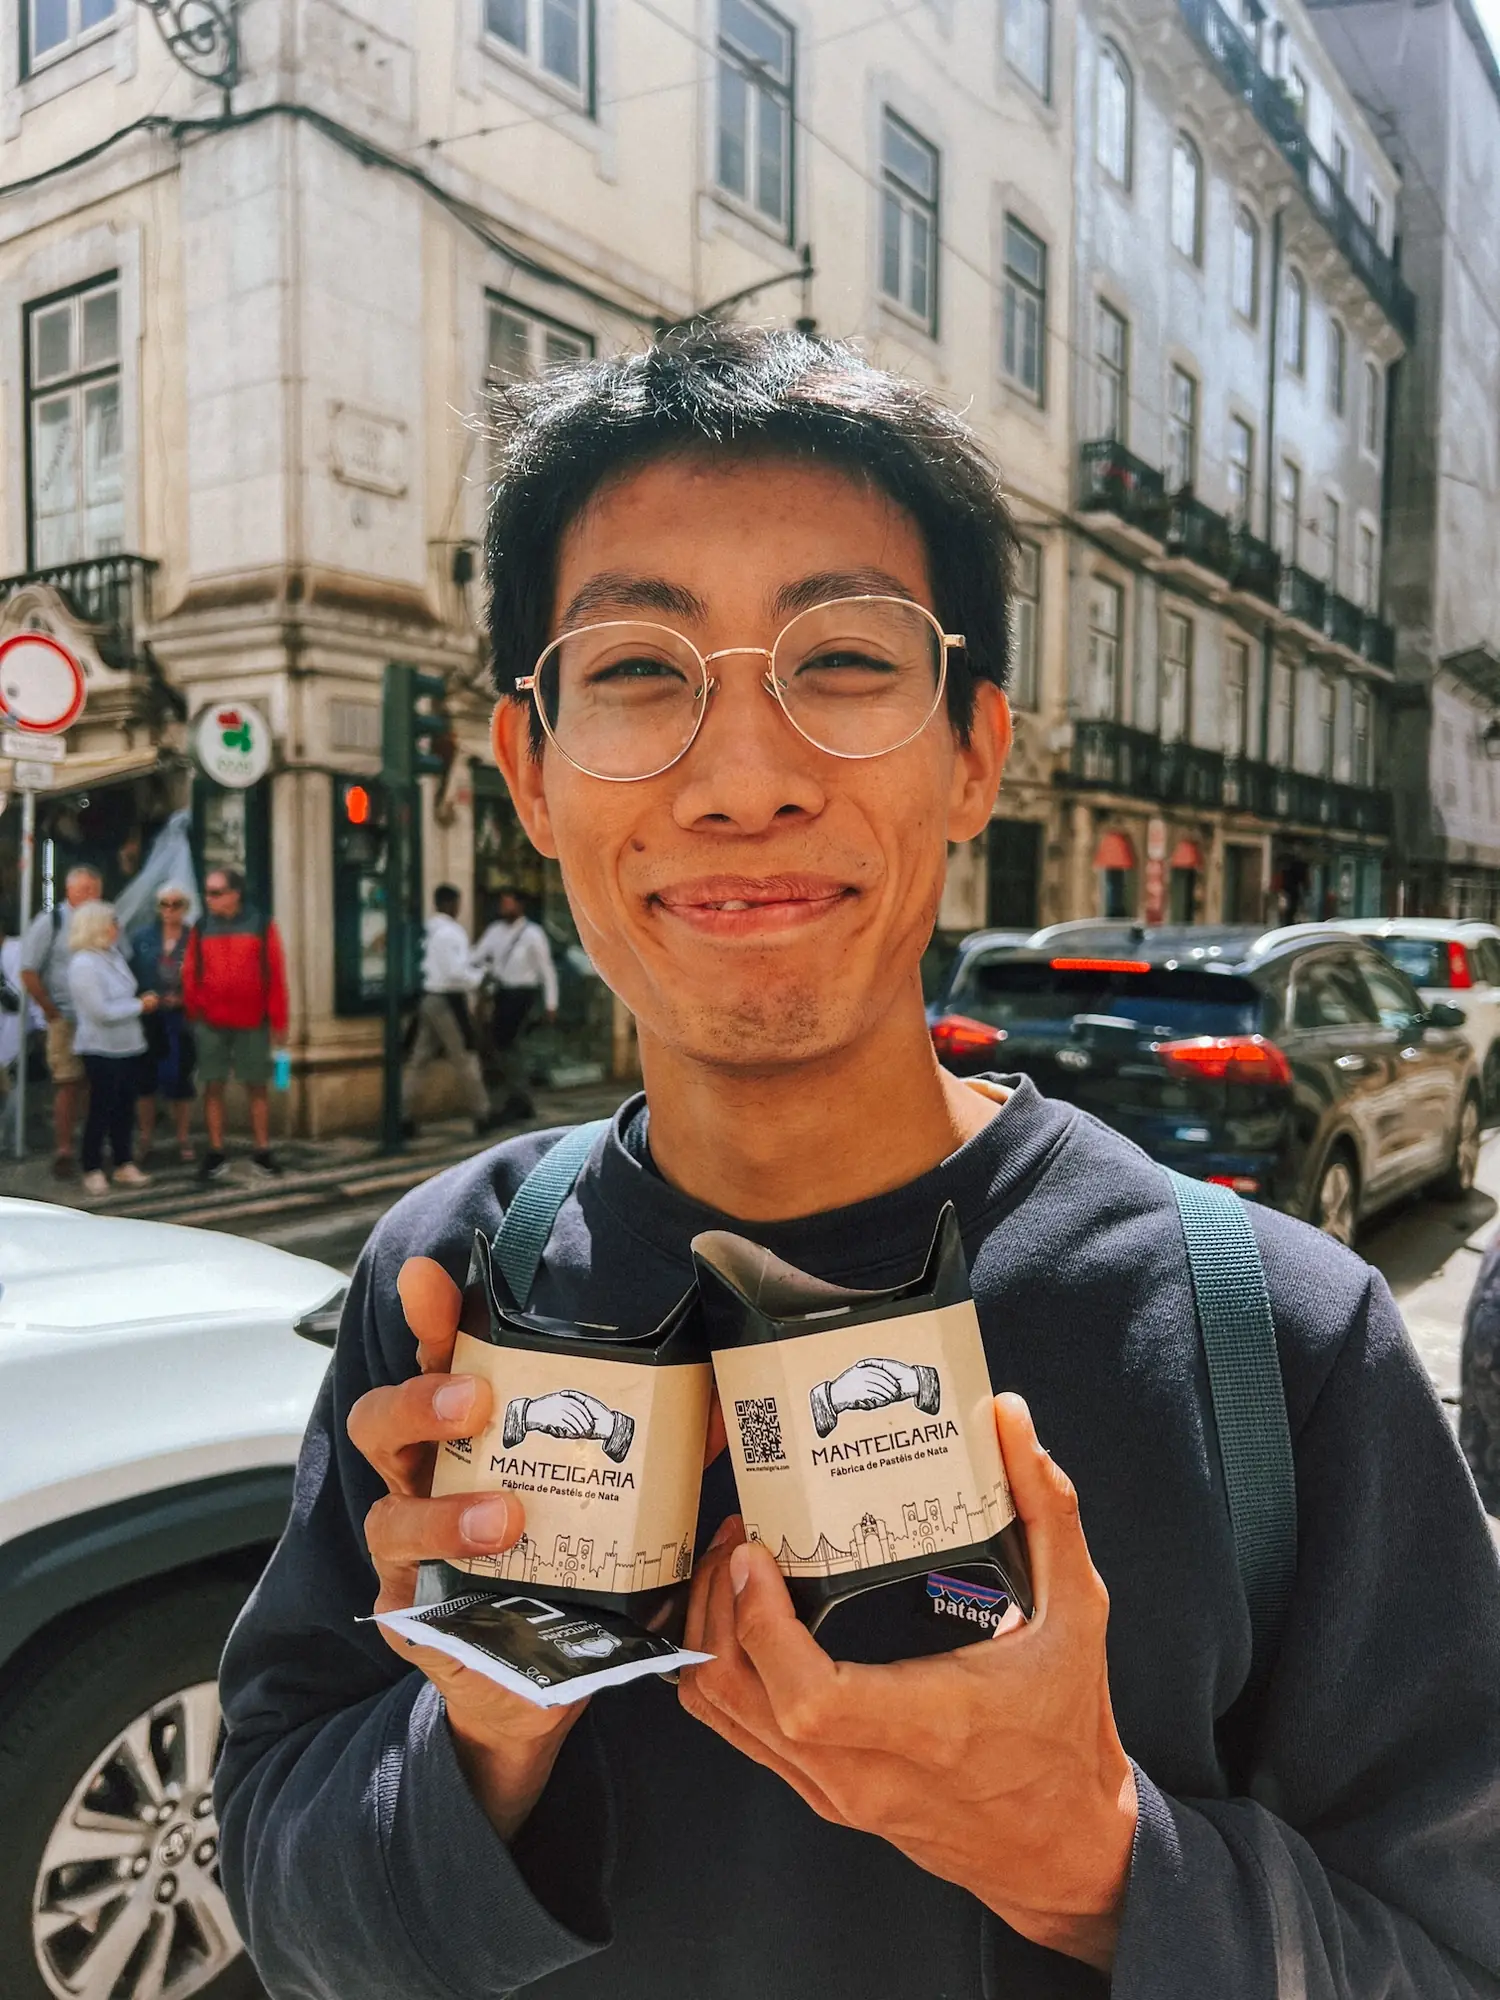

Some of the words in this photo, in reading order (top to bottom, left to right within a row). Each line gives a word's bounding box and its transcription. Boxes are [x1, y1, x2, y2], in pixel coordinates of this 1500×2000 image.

[811, 1420, 959, 1466] MANTEIGARIA
[489, 1455, 635, 1489] MANTEIGARIA
[830, 1464, 865, 1477] Fábrica
[866, 1461, 878, 1470] de
[879, 1455, 913, 1467] Pastéis
[914, 1450, 926, 1460] de
[926, 1445, 949, 1457] Nata
[501, 1479, 535, 1492] Fábrica
[536, 1483, 549, 1493] de
[549, 1485, 583, 1498] Pastéis
[584, 1490, 597, 1499] de
[597, 1491, 620, 1502] Nata
[933, 1597, 1002, 1629] patago
